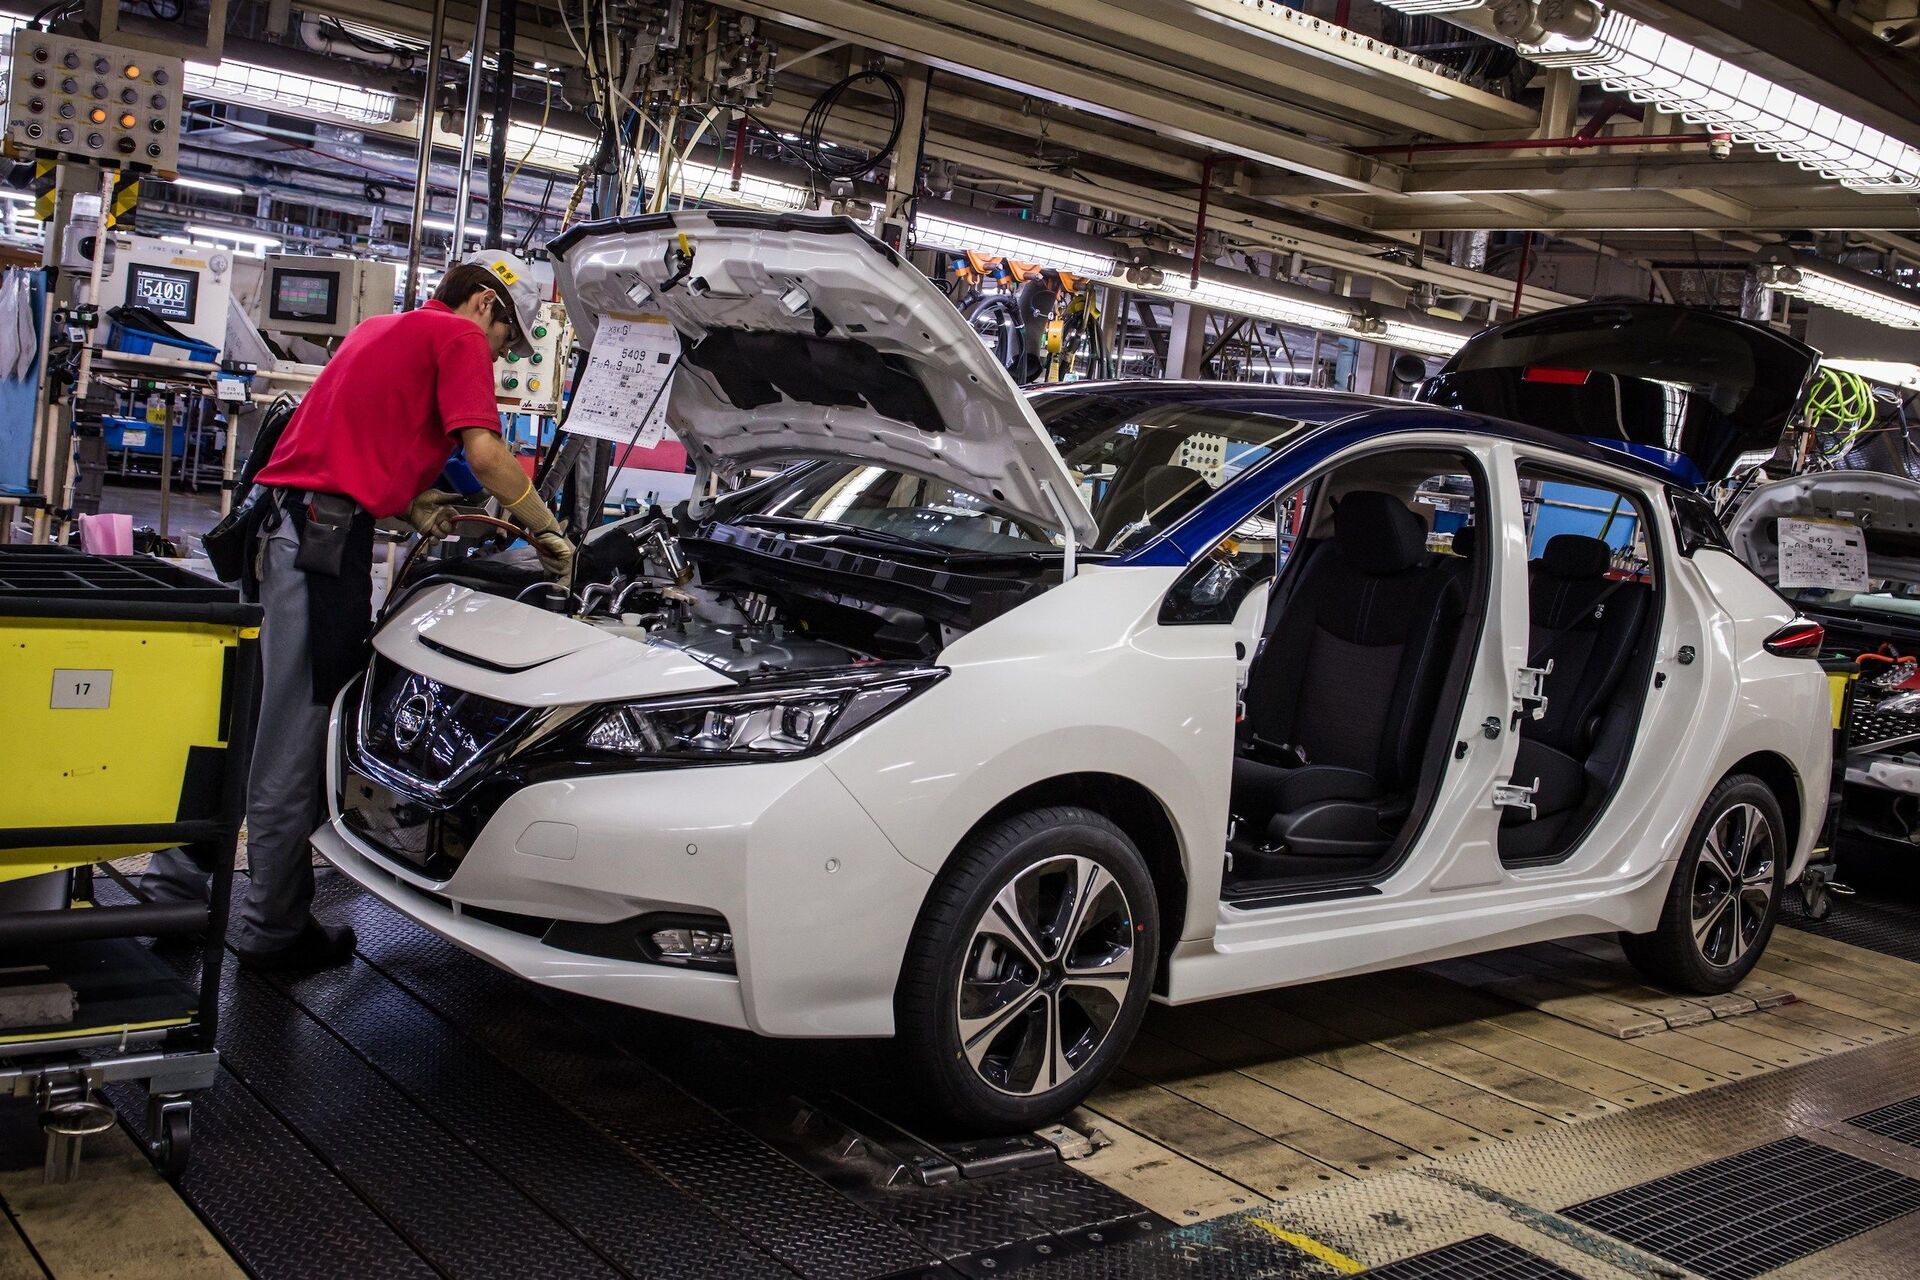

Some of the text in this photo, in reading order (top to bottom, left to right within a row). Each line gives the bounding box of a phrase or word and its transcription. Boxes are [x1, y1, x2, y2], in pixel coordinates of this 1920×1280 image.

[143, 279, 184, 301] 5409
[621, 348, 646, 362] 5409
[1808, 536, 1833, 545] 5410
[74, 683, 91, 695] 17
